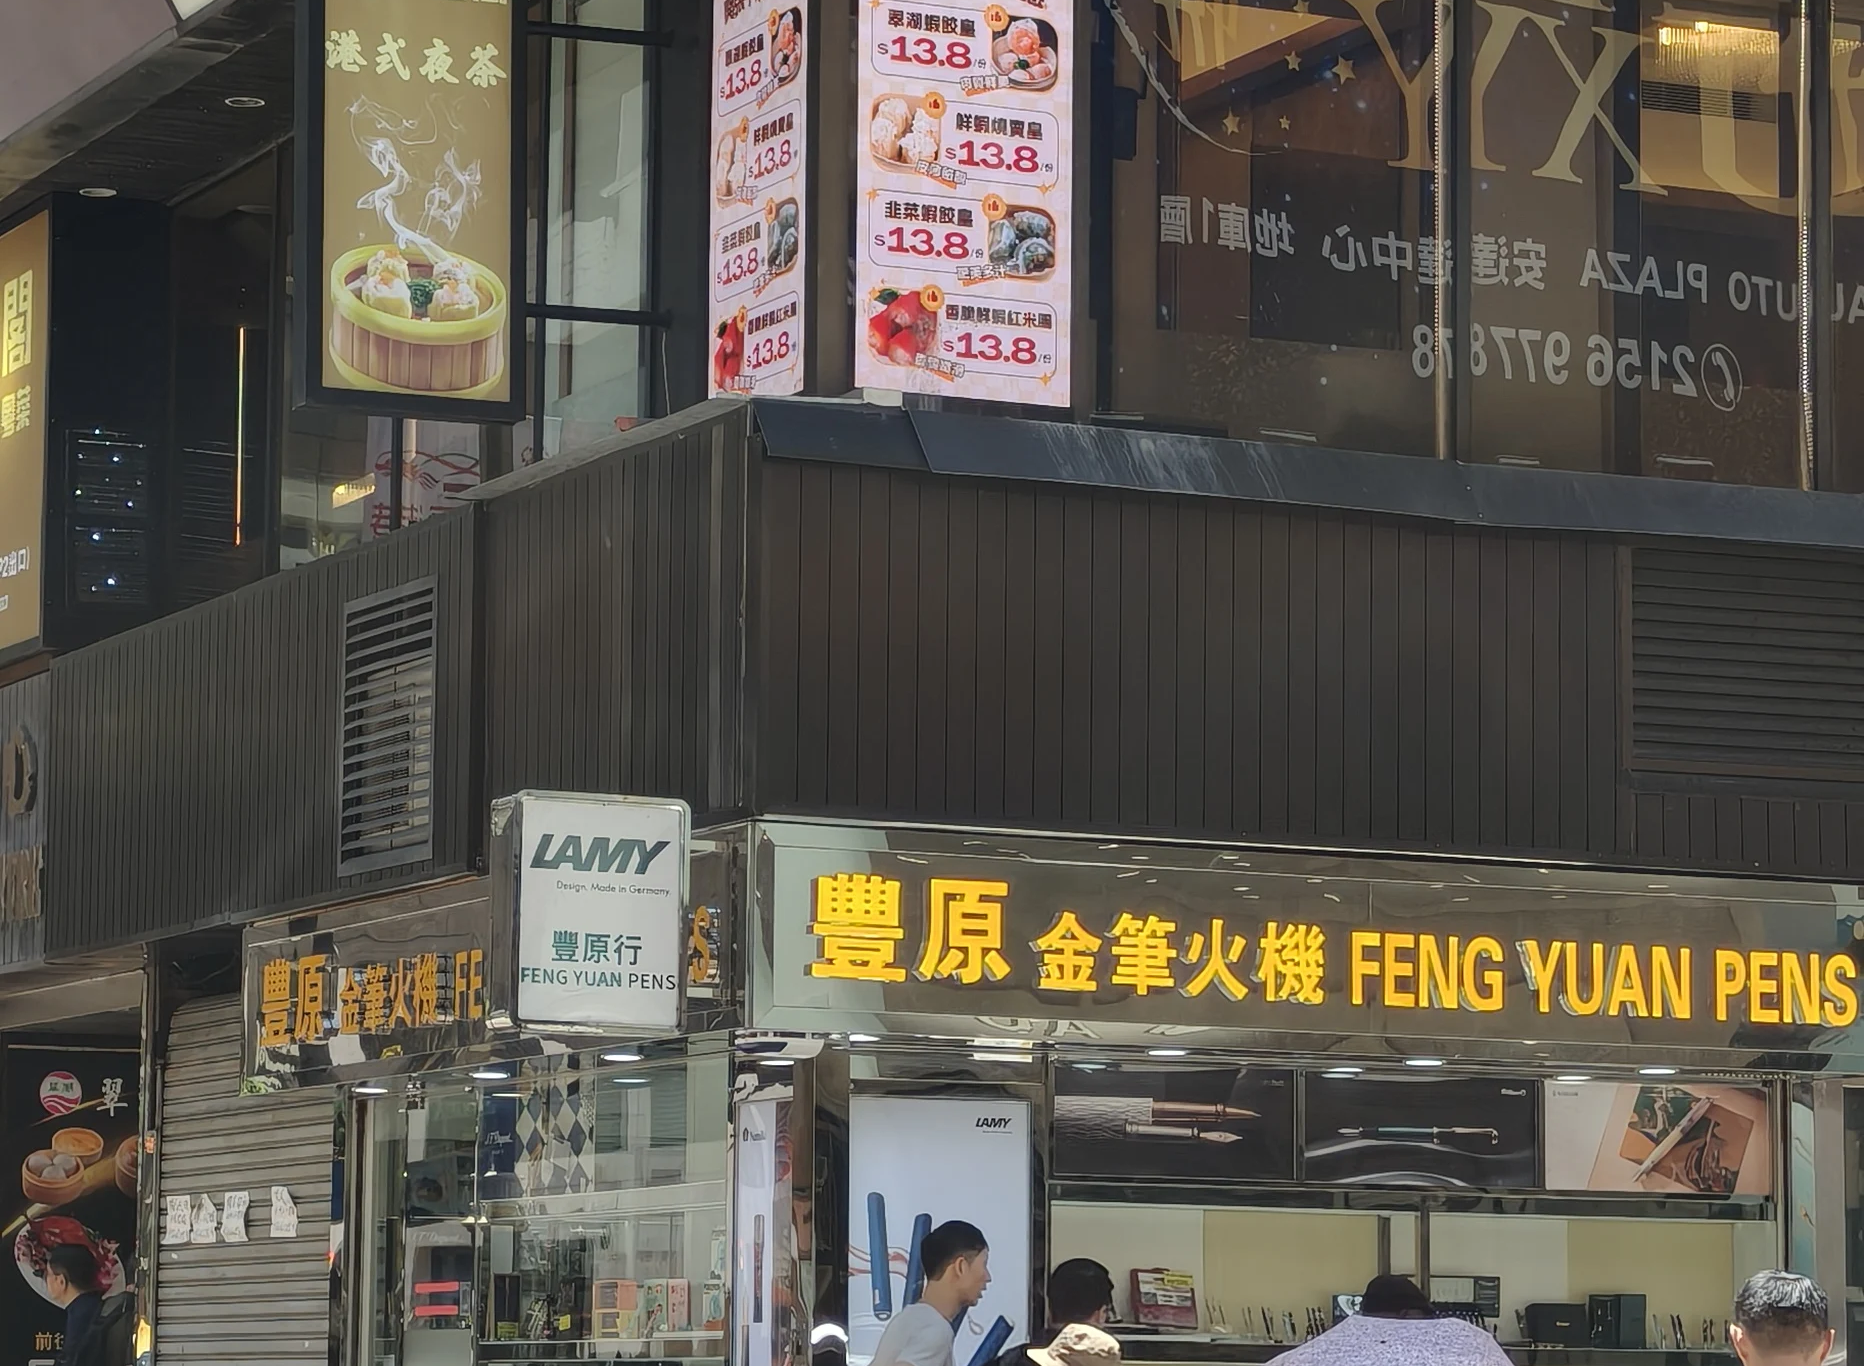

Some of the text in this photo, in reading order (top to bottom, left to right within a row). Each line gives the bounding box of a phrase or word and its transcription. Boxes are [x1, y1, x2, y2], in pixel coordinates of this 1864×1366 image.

[324, 29, 508, 89] 港式夜茶
[529, 833, 672, 876] LAMY
[591, 882, 616, 894] Made
[551, 930, 643, 966] 豐原行
[810, 873, 1859, 1027] 豐原 金筆火機 FENG YUAN PENS
[521, 966, 677, 991] FENG YUAN PENS
[260, 954, 328, 1048] 豐原
[339, 950, 439, 1036] 金筆火機
[96, 1078, 128, 1117] 翠
[975, 1117, 1012, 1129] LAMY
